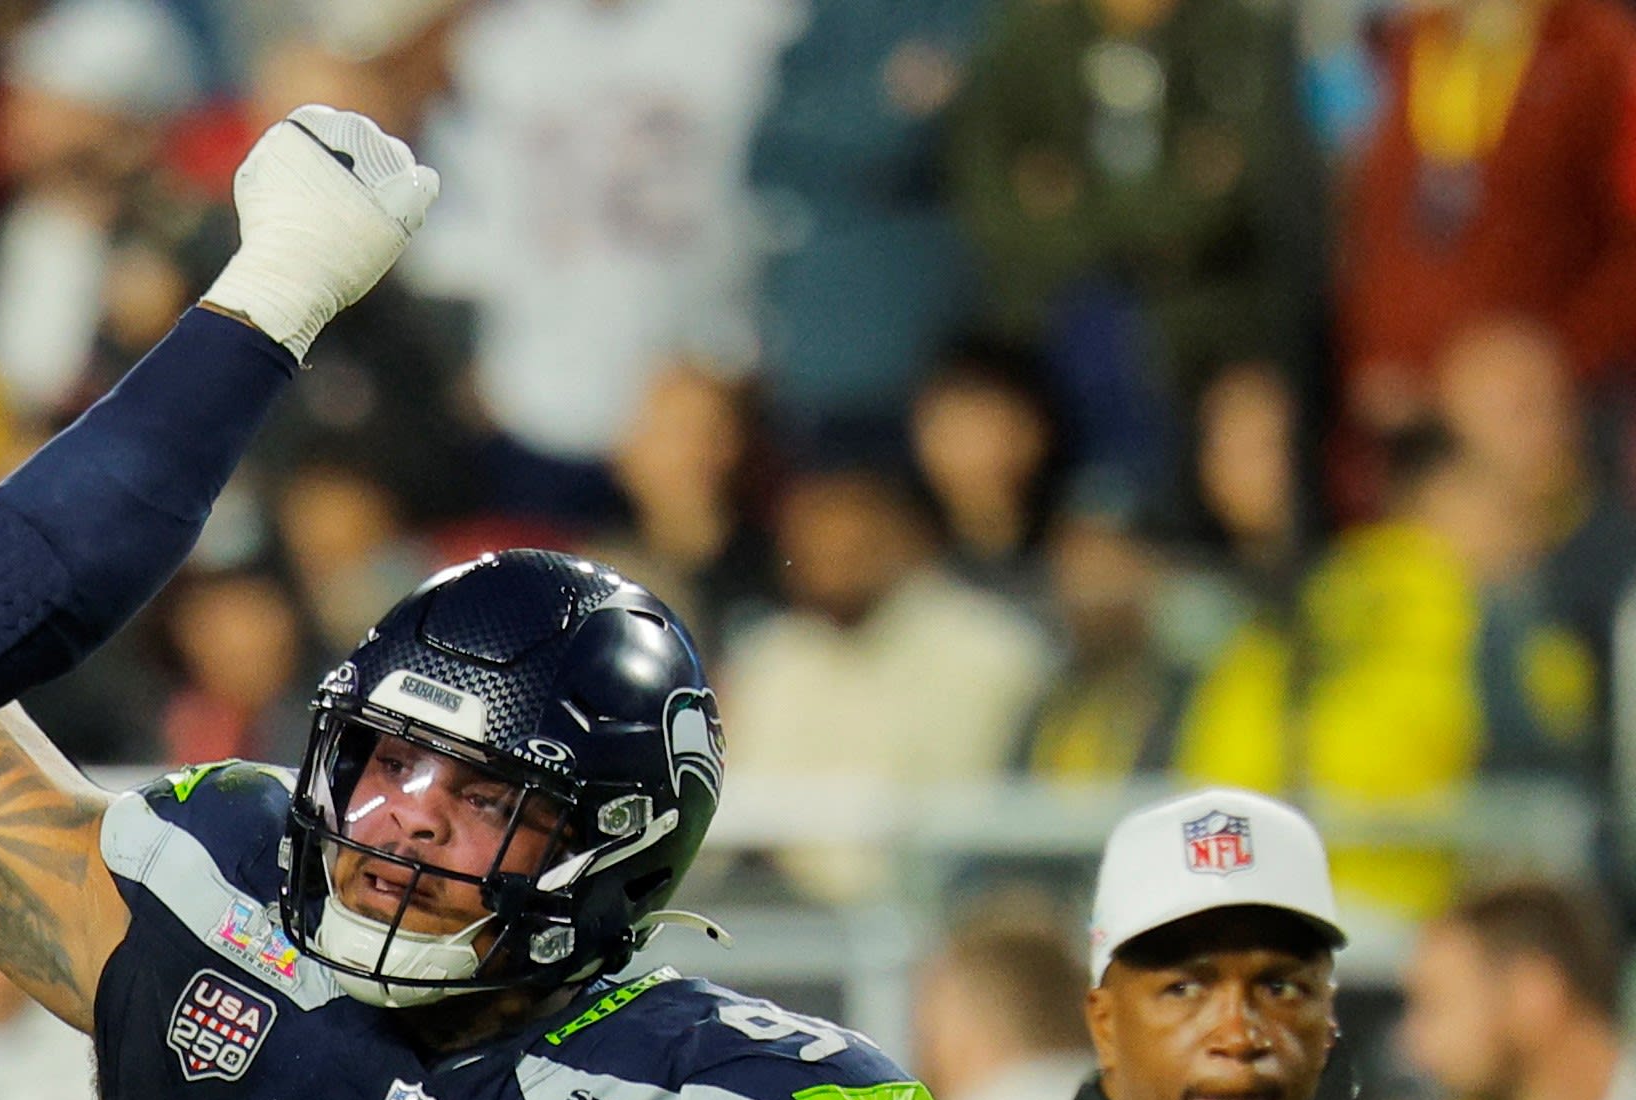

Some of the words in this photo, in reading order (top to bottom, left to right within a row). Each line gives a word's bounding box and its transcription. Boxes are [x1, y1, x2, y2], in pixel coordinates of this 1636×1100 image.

[1191, 834, 1253, 870] NFL
[222, 940, 255, 969] SUPER
[255, 961, 283, 982] BOWL
[193, 980, 261, 1034] USA
[172, 1017, 248, 1075] 250
